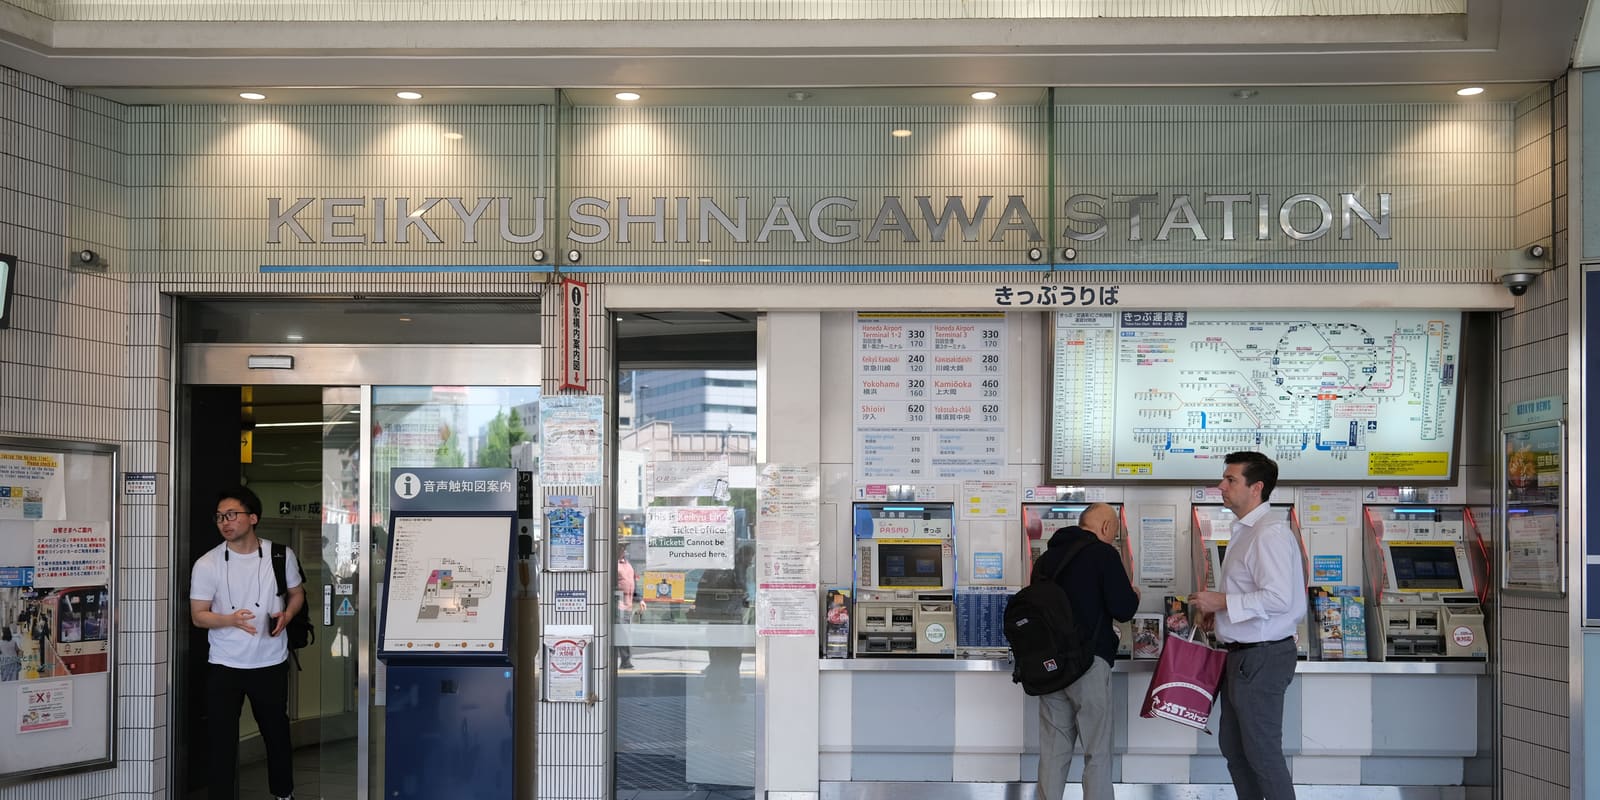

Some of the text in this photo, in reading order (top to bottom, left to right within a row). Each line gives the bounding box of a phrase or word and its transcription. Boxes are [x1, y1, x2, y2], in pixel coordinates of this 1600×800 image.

[266, 192, 1392, 245] KEIKYU SHINAGAWA STATION
[995, 285, 1119, 306] きっぷうりば
[1124, 312, 1185, 322] きっぷ運賃表
[908, 330, 924, 338] 330
[982, 330, 998, 338] 330
[908, 404, 924, 412] 620
[982, 404, 998, 412] 620
[1516, 400, 1552, 416] KEIKYU NEWS
[424, 480, 512, 493] 音声触知図案内
[858, 489, 864, 498] 1
[1026, 490, 1034, 498] 2
[1196, 490, 1204, 498] 3
[1366, 490, 1375, 499] 4
[26, 571, 34, 583] 3
